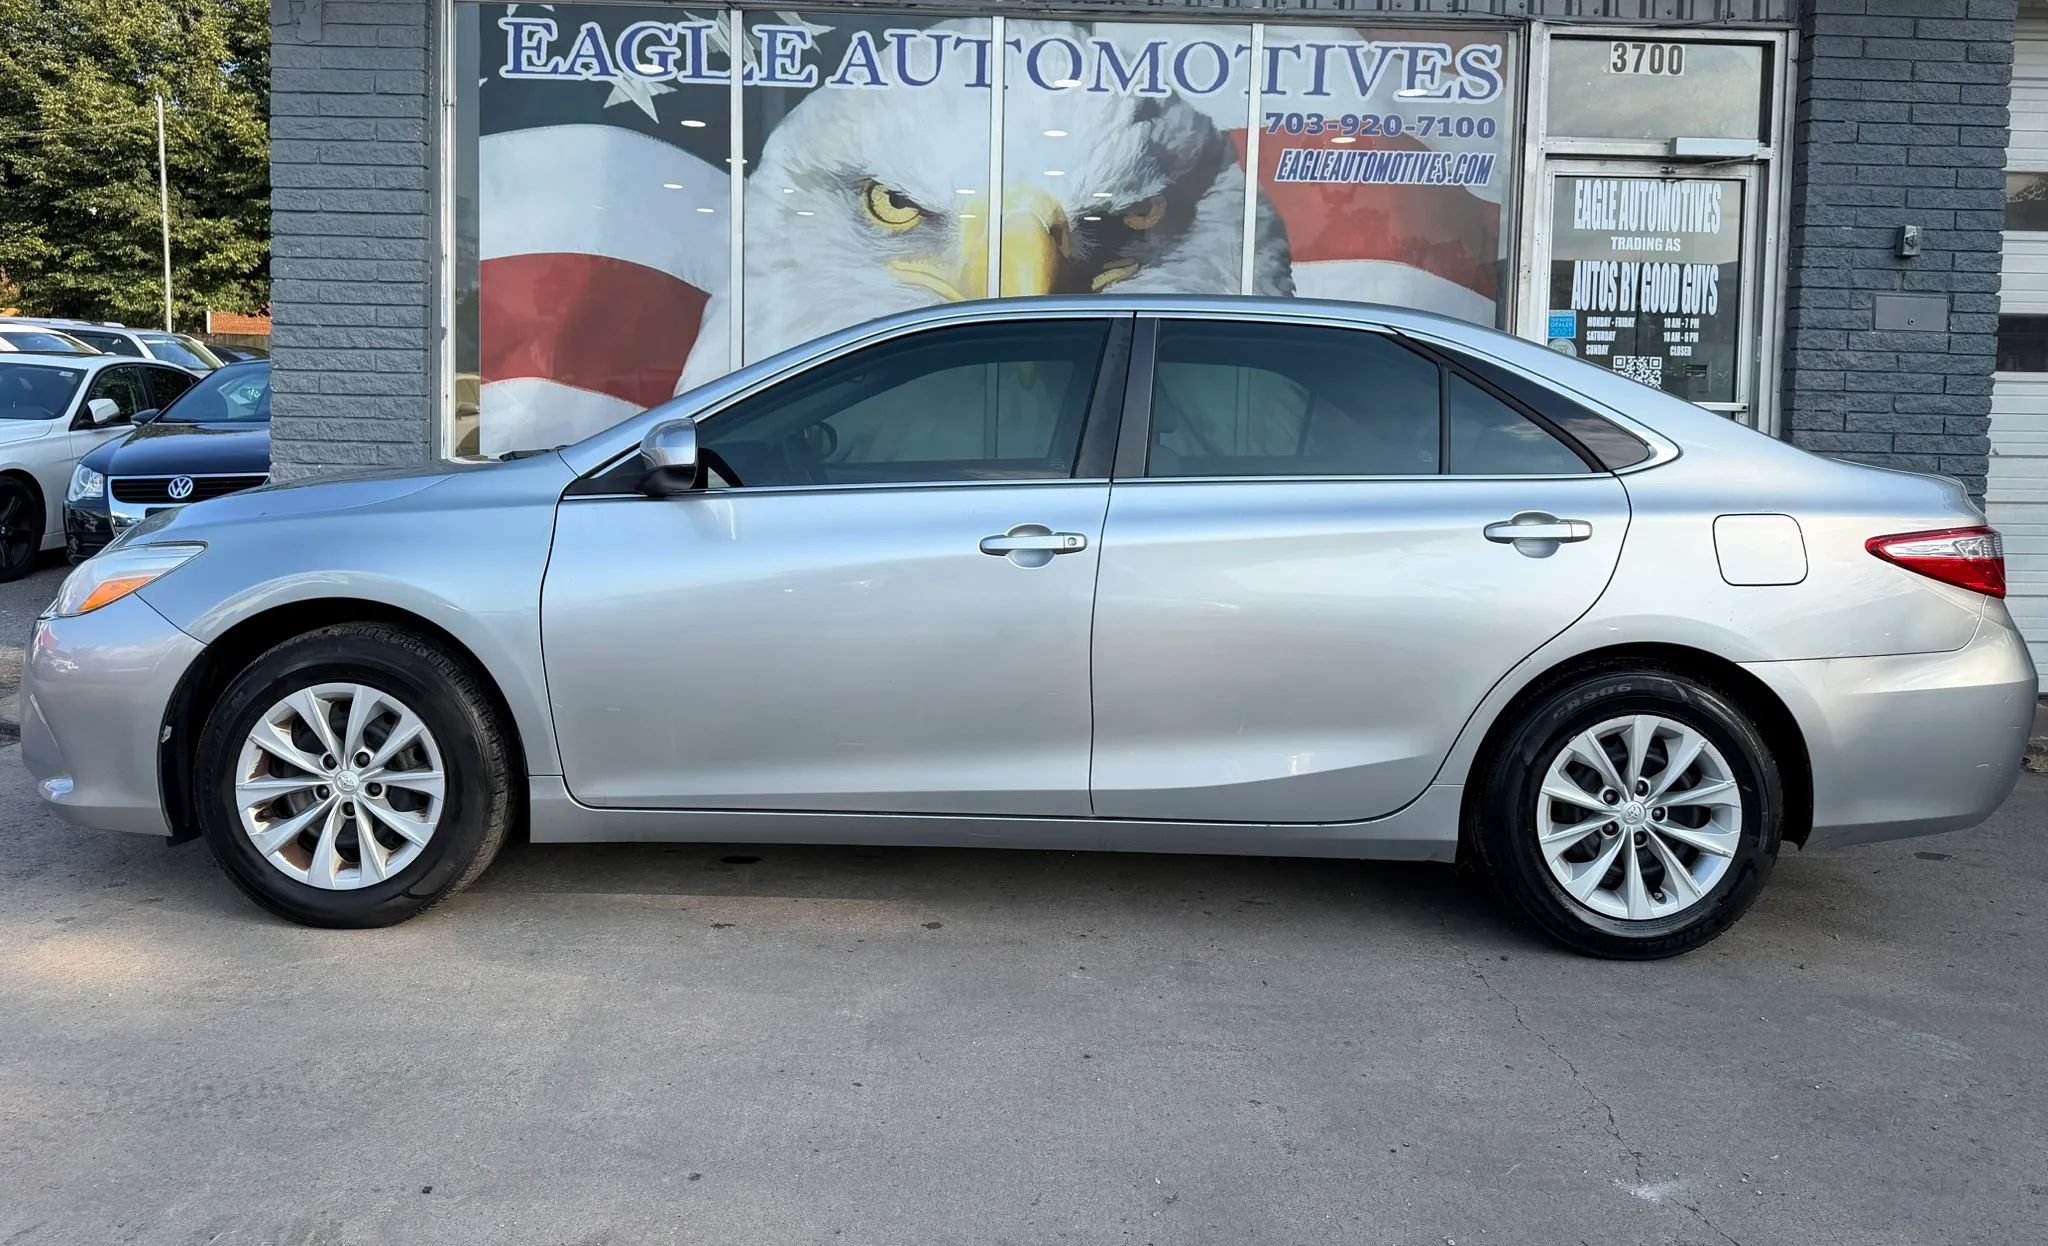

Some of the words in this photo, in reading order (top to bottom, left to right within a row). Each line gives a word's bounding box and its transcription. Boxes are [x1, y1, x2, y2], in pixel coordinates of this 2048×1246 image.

[500, 17, 818, 88] EAGLE
[828, 30, 1503, 104] AUTOMOTIVES
[1612, 42, 1683, 75] 3700
[1265, 112, 1497, 139] 703-920-7100
[1275, 148, 1496, 186] EAGLEAUTOMOTIVES.COM
[1574, 179, 1618, 231] EAGLE
[1618, 180, 1721, 234] AUTOMOTIVES
[1611, 236, 1662, 251] TRADING
[1665, 237, 1681, 252] AS
[1571, 260, 1618, 312] AUTOS
[1620, 261, 1640, 312] BY
[1641, 261, 1680, 314] GOOD
[1681, 263, 1719, 315] GUYS
[1587, 316, 1611, 327] MONDAY
[1615, 317, 1636, 328] FRIDAY
[1671, 318, 1681, 328] AM
[1690, 318, 1699, 329] PM
[1551, 328, 1572, 336] 2021
[1586, 330, 1616, 341] SATURDAY
[1670, 332, 1680, 342] AM
[1689, 332, 1699, 343] PM
[1586, 344, 1609, 355] SUNDAY
[1670, 345, 1692, 356] CLOSED
